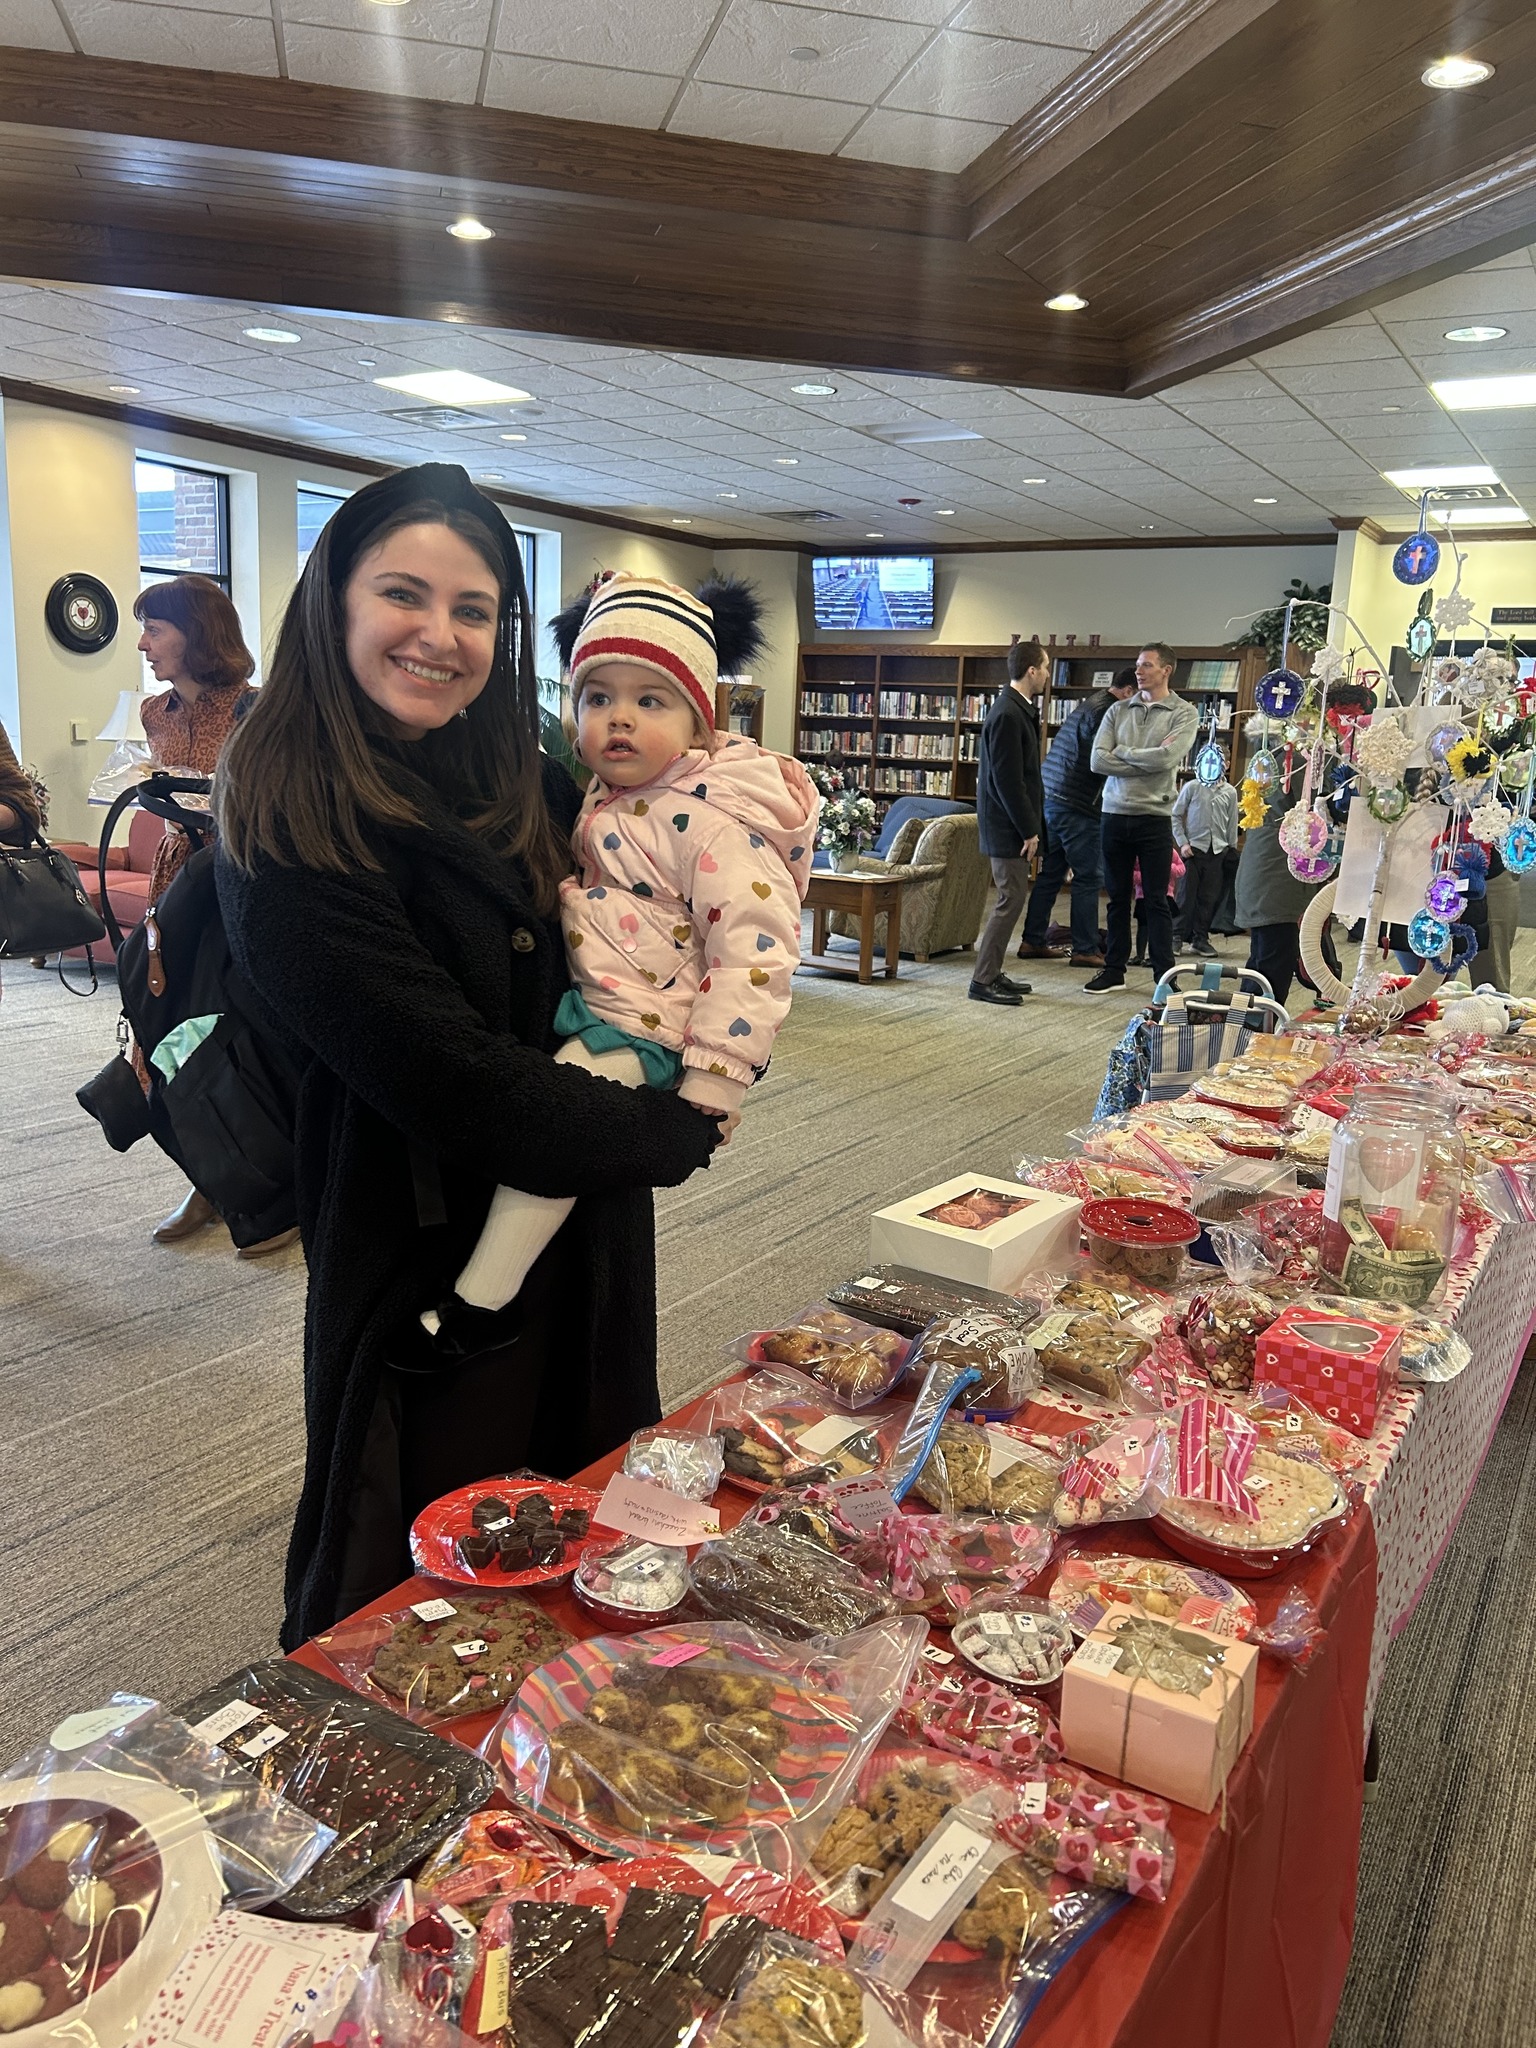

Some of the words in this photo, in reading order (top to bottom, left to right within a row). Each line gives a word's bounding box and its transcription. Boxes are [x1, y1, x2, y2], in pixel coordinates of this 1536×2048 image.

[1011, 634, 1101, 646] FAITH
[850, 1499, 887, 1509] Toffee
[205, 1708, 237, 1731] Bars
[216, 1710, 254, 1734] Toffee
[497, 1953, 508, 1985] Toffee
[273, 1961, 311, 2007] Nana's
[498, 1989, 508, 2016] Bars
